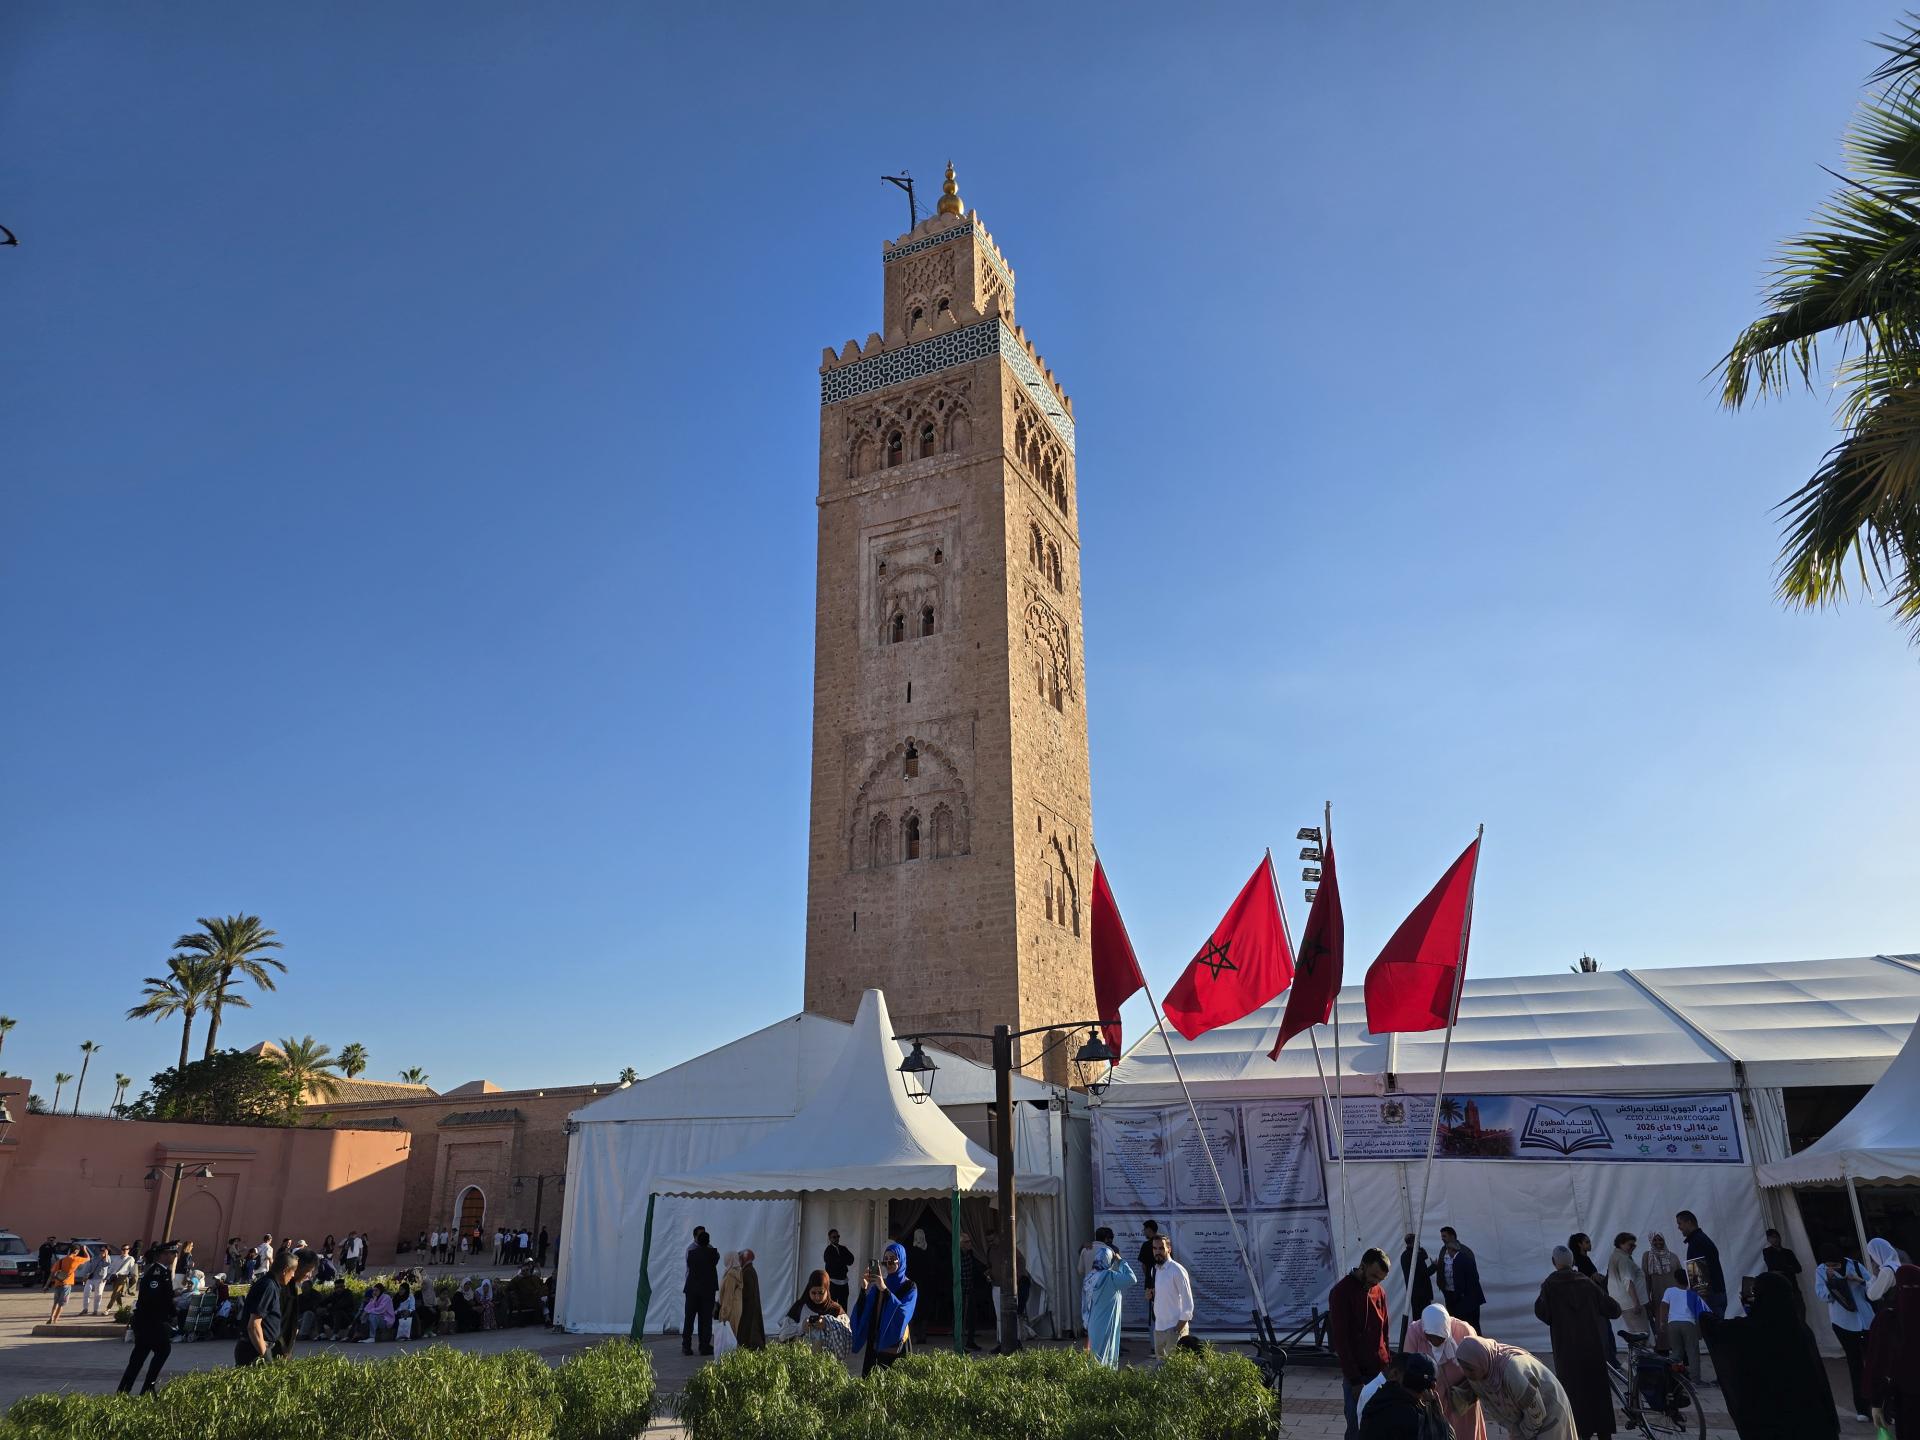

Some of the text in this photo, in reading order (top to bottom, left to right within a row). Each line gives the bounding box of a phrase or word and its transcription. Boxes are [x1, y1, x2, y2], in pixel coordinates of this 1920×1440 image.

[1616, 1104, 1728, 1114] المعرض الجهوي للكتاب بمراكش
[1636, 1123, 1655, 1131] 2026
[1657, 1124, 1671, 1133] ماي
[1684, 1123, 1695, 1132] إلى
[1657, 1134, 1682, 1142] بمراكش
